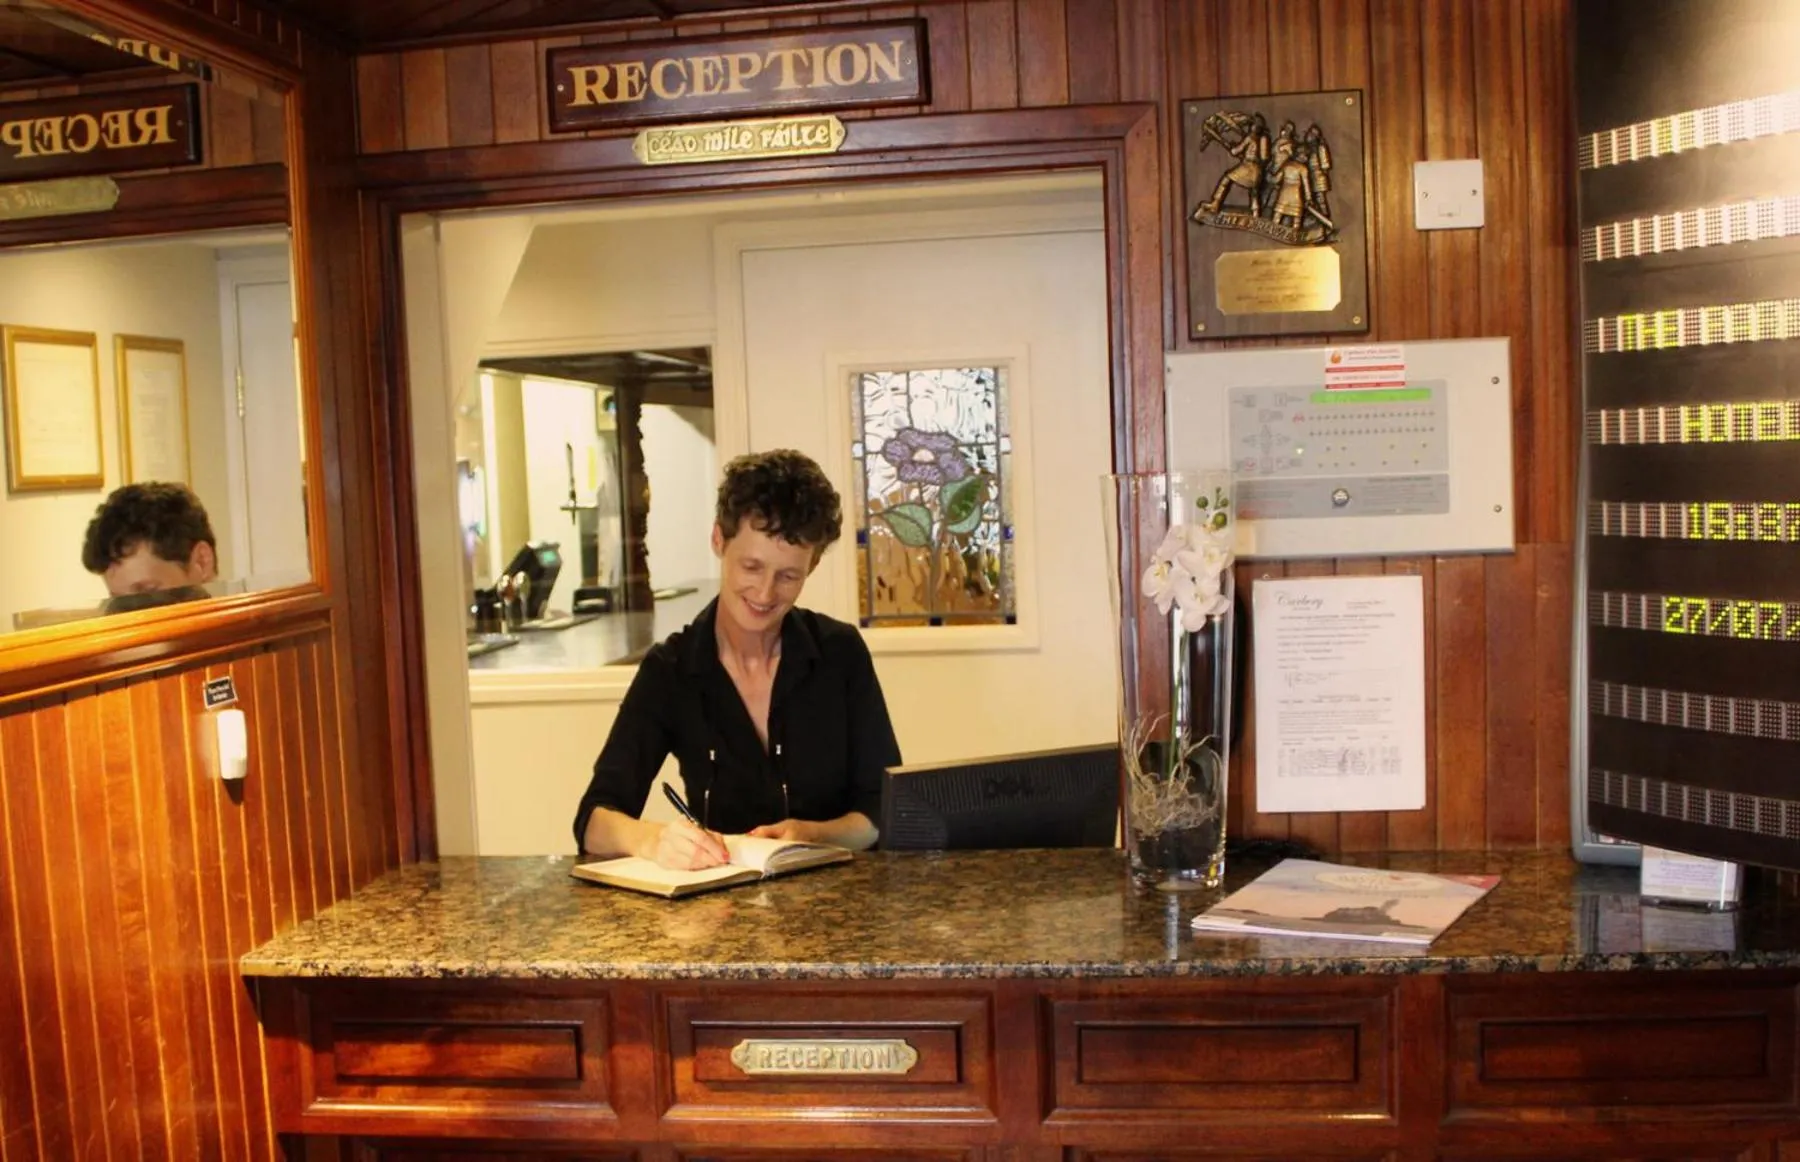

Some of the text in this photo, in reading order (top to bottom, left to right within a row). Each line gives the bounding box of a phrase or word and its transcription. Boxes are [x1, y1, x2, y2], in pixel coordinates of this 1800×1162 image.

[566, 40, 904, 107] RECEPTION
[1619, 310, 1678, 350] THE
[758, 1046, 892, 1069] RECEPTION
